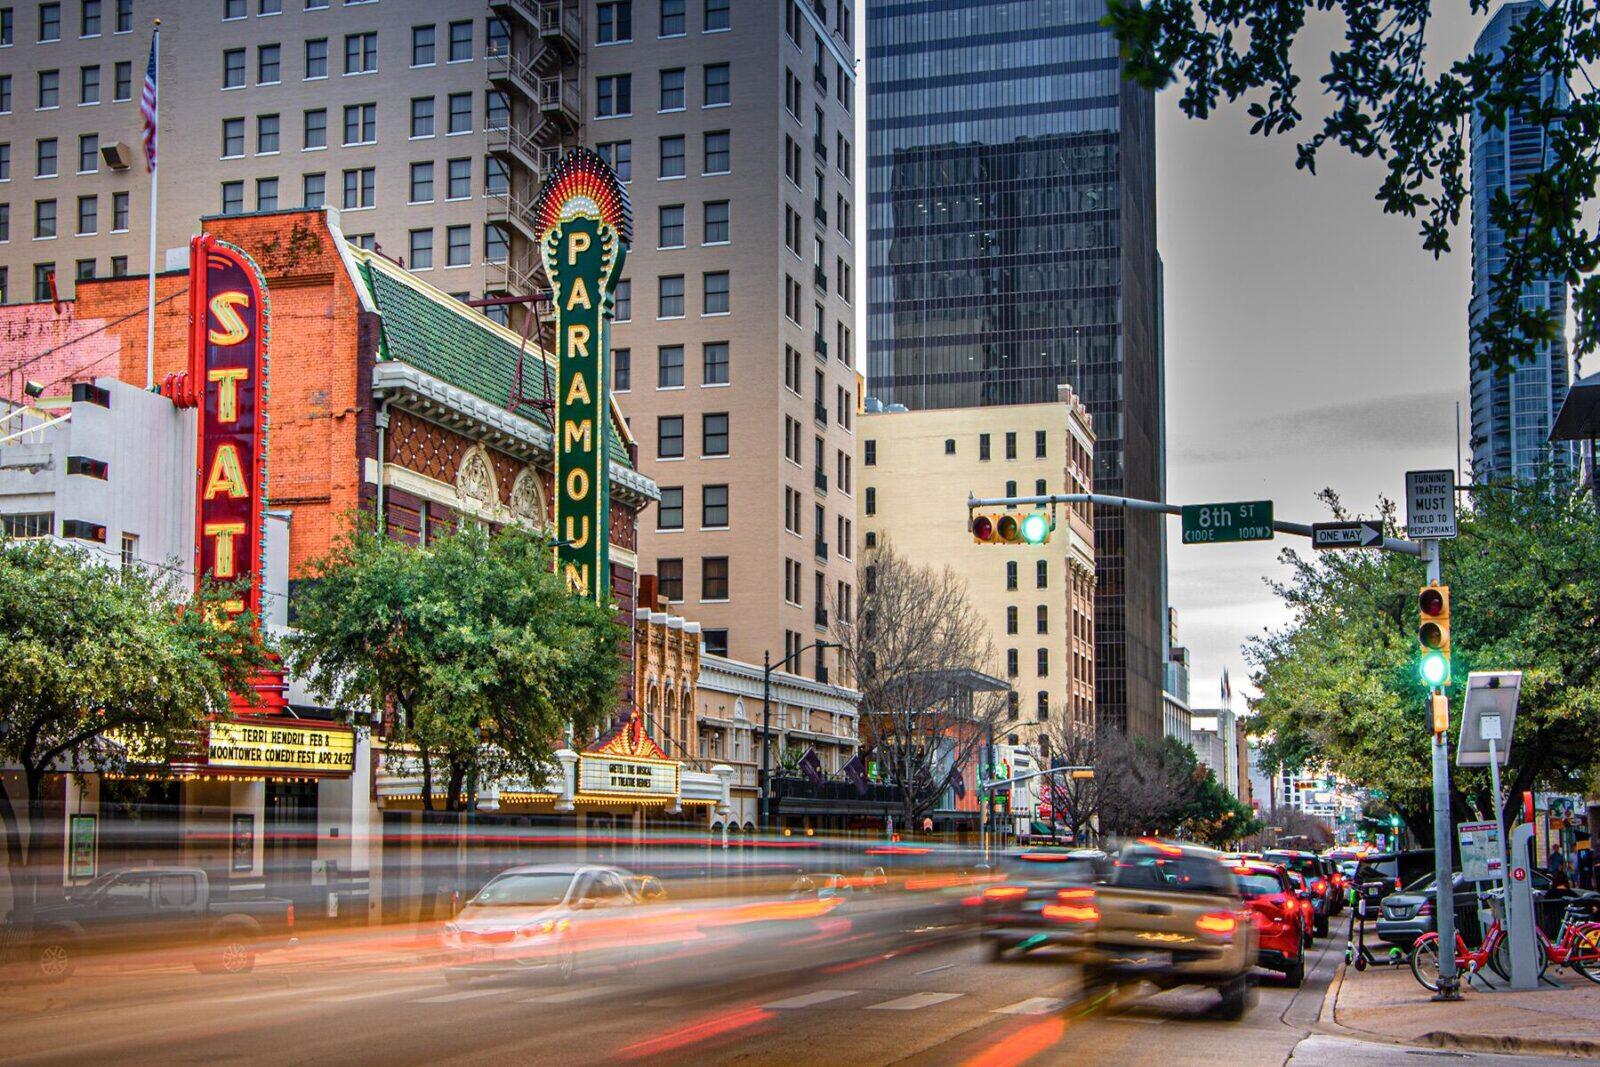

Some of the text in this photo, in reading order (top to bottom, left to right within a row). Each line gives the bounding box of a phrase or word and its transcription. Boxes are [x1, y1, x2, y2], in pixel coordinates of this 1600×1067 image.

[565, 232, 592, 597] PARAMOUN
[1414, 473, 1447, 483] TURNING
[1415, 485, 1447, 495] TRAFFIC
[1416, 497, 1446, 511] MUST
[1199, 504, 1254, 528] 8th ST
[1412, 514, 1447, 524] YIELD TO
[1319, 529, 1362, 541] ONE WAY
[1410, 525, 1454, 535] PEDESTRIANS
[242, 728, 268, 743] TERRI
[271, 730, 305, 746] HENDRIX
[309, 733, 323, 747] FEB
[209, 745, 262, 761] MOONTOWER
[265, 748, 294, 763] COMEDY
[297, 750, 316, 764] FEST
[318, 751, 332, 765] APR
